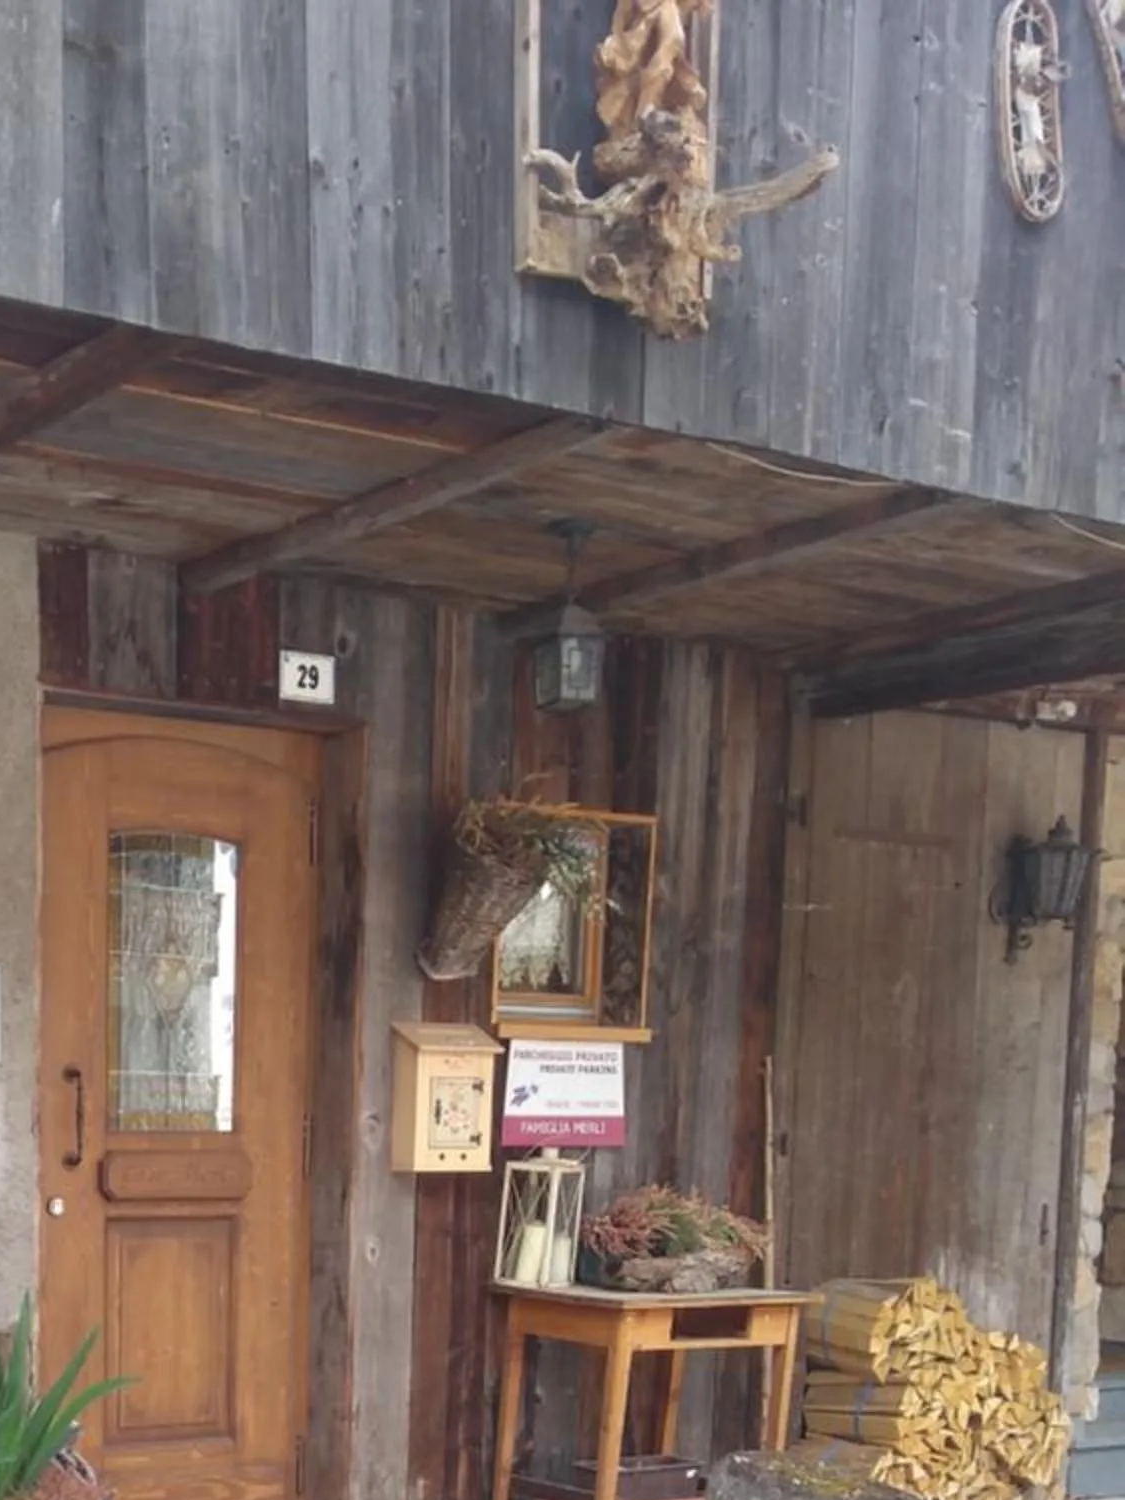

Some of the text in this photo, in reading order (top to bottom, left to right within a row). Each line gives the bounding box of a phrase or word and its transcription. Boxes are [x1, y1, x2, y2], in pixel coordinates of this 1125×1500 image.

[296, 663, 320, 690] 29
[575, 1051, 619, 1062] PRIVATO
[539, 1064, 618, 1074] PRIVATE PARKING
[520, 1121, 572, 1135] FAMIGLIA
